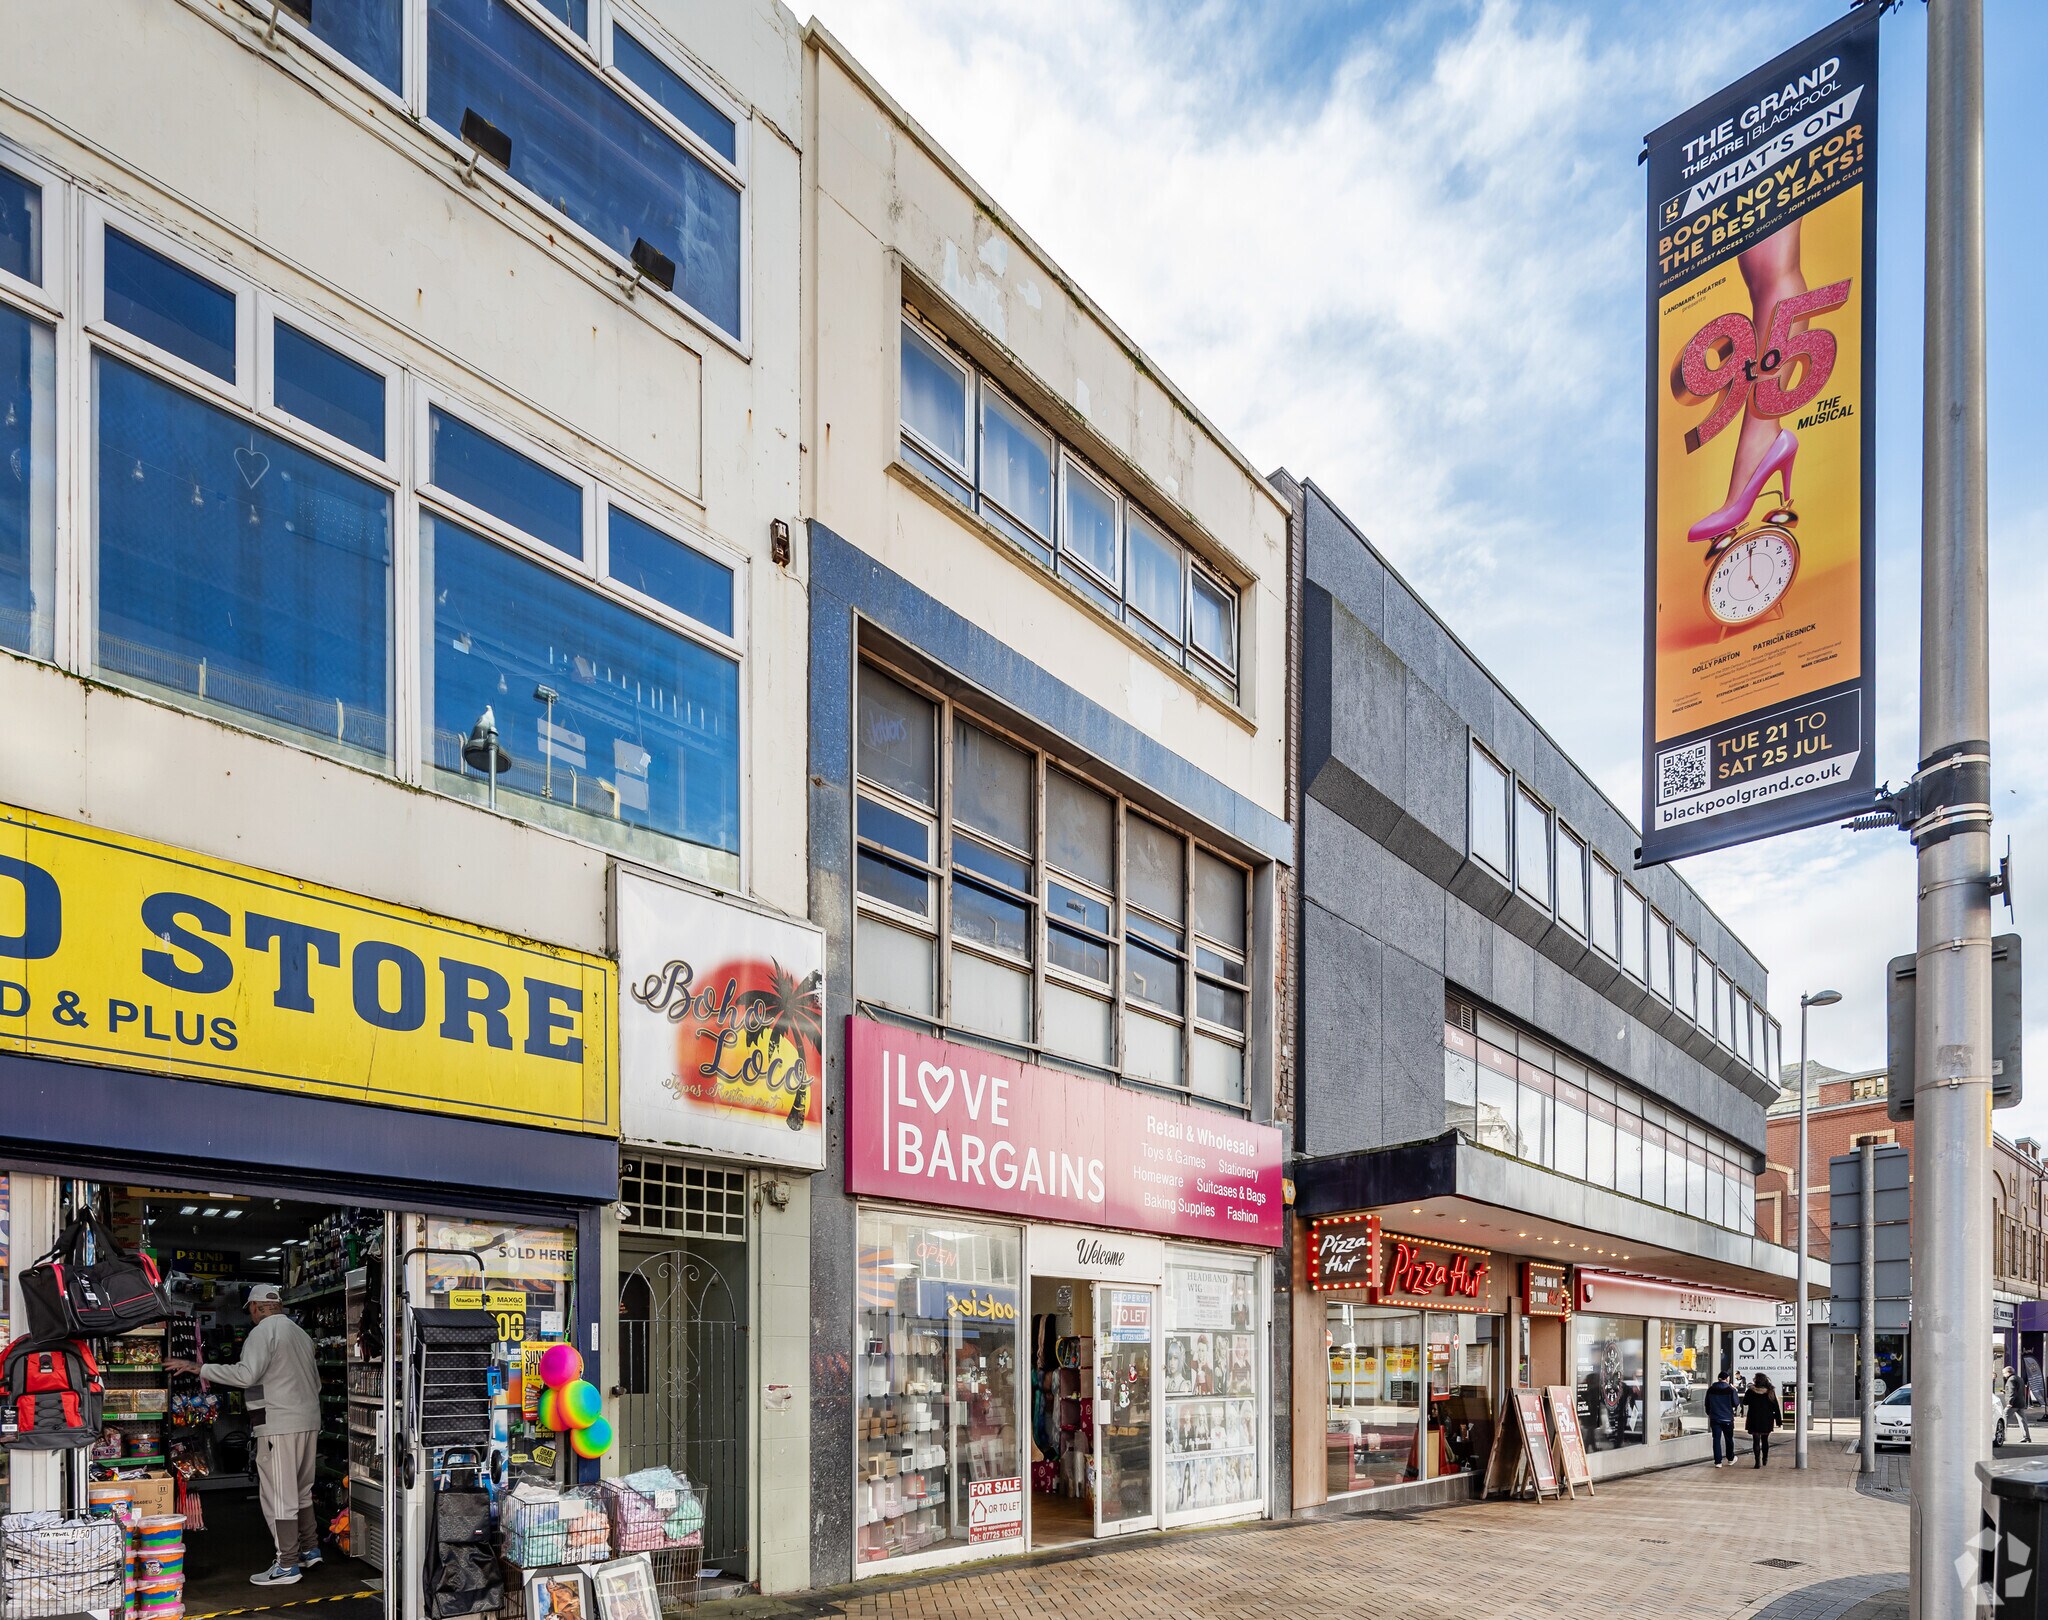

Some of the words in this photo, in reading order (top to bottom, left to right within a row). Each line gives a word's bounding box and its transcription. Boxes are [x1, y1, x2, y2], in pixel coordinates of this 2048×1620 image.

[1681, 118, 1734, 162] THE
[1740, 56, 1840, 129] GRAND
[1681, 136, 1744, 179] THEATRE
[1752, 80, 1842, 140] BLACKPOOL
[1696, 134, 1794, 201] WHAT'S
[1804, 102, 1844, 138] ON
[1659, 202, 1728, 257] BOOK
[1737, 158, 1802, 212] NOW
[1808, 124, 1863, 168] FOR
[1659, 238, 1704, 275] THE
[1712, 198, 1771, 247] BEST
[1777, 142, 1863, 208] SEATS!
[1659, 267, 1690, 288] PRIORITY
[1697, 252, 1715, 267] FIRST
[1716, 238, 1743, 256] ACCESS
[1744, 232, 1755, 240] TO
[1756, 213, 1783, 234] SHOWS
[1788, 200, 1805, 214] JOIN
[1807, 190, 1822, 202] THE
[1842, 166, 1863, 181] CLUB
[1664, 293, 1696, 316] LANDMARK
[1696, 276, 1727, 299] THEATRES
[1742, 348, 1781, 382] to
[1752, 277, 1853, 420] 5
[1672, 312, 1758, 453] 9
[1797, 404, 1854, 431] MUSICAL
[1816, 395, 1842, 413] THE
[1717, 568, 1729, 578] 10
[1752, 634, 1784, 652] PATRICIA
[1785, 623, 1816, 640] RESNICK
[1692, 661, 1712, 674] DOLLY
[1713, 651, 1740, 666] PARTON
[1718, 731, 1759, 757] TUE
[1766, 722, 1788, 743] 21
[1795, 711, 1827, 733] TO
[1718, 754, 1756, 779] SAT
[1762, 745, 1788, 767] 25
[1794, 734, 1832, 759] JUL
[1664, 763, 1841, 822] blackpoolgrand.co.uk
[141, 891, 584, 1064] STORE
[631, 960, 775, 1033] Boho
[52, 990, 89, 1029] &
[109, 998, 238, 1051] PLUS
[696, 1028, 814, 1093] Loco
[661, 1072, 703, 1100] Tapas
[1147, 1115, 1183, 1140] Retail
[1187, 1125, 1194, 1142] &
[1197, 1127, 1255, 1157] Wholesale
[898, 1121, 1105, 1203] BARGAINS
[1142, 1142, 1164, 1162] Toys
[1166, 1147, 1173, 1161] &
[1175, 1149, 1206, 1169] Games
[1219, 1159, 1259, 1183] Stationery
[1133, 1165, 1184, 1188] Homeware
[1197, 1178, 1237, 1199] Suitcases
[1239, 1186, 1245, 1199] &
[1247, 1188, 1266, 1206] Bags
[1144, 1192, 1176, 1214] Baking
[1178, 1198, 1215, 1217] Supplies
[1228, 1206, 1258, 1223] Fashion
[499, 1246, 535, 1259] SOLD
[540, 1249, 573, 1262] HERE
[916, 1242, 957, 1266] OPEN
[1076, 1239, 1125, 1266] Welcome
[1320, 1233, 1367, 1256] Pizza
[1325, 1254, 1360, 1275] Hut
[1187, 1271, 1228, 1284] HEADBAND
[1187, 1283, 1203, 1293] WIG
[1384, 1243, 1447, 1296] Pizza
[1446, 1253, 1488, 1297] Hut
[1113, 1293, 1149, 1303] PROPERTY
[1117, 1309, 1128, 1322] TO
[1130, 1309, 1146, 1322] LET
[971, 1483, 992, 1496] FOR
[995, 1479, 1020, 1493] SALE
[989, 1504, 998, 1513] OR
[999, 1502, 1007, 1512] TO
[1009, 1501, 1020, 1511] LET
[971, 1533, 981, 1542] Tel:
[983, 1531, 1000, 1540] 07725
